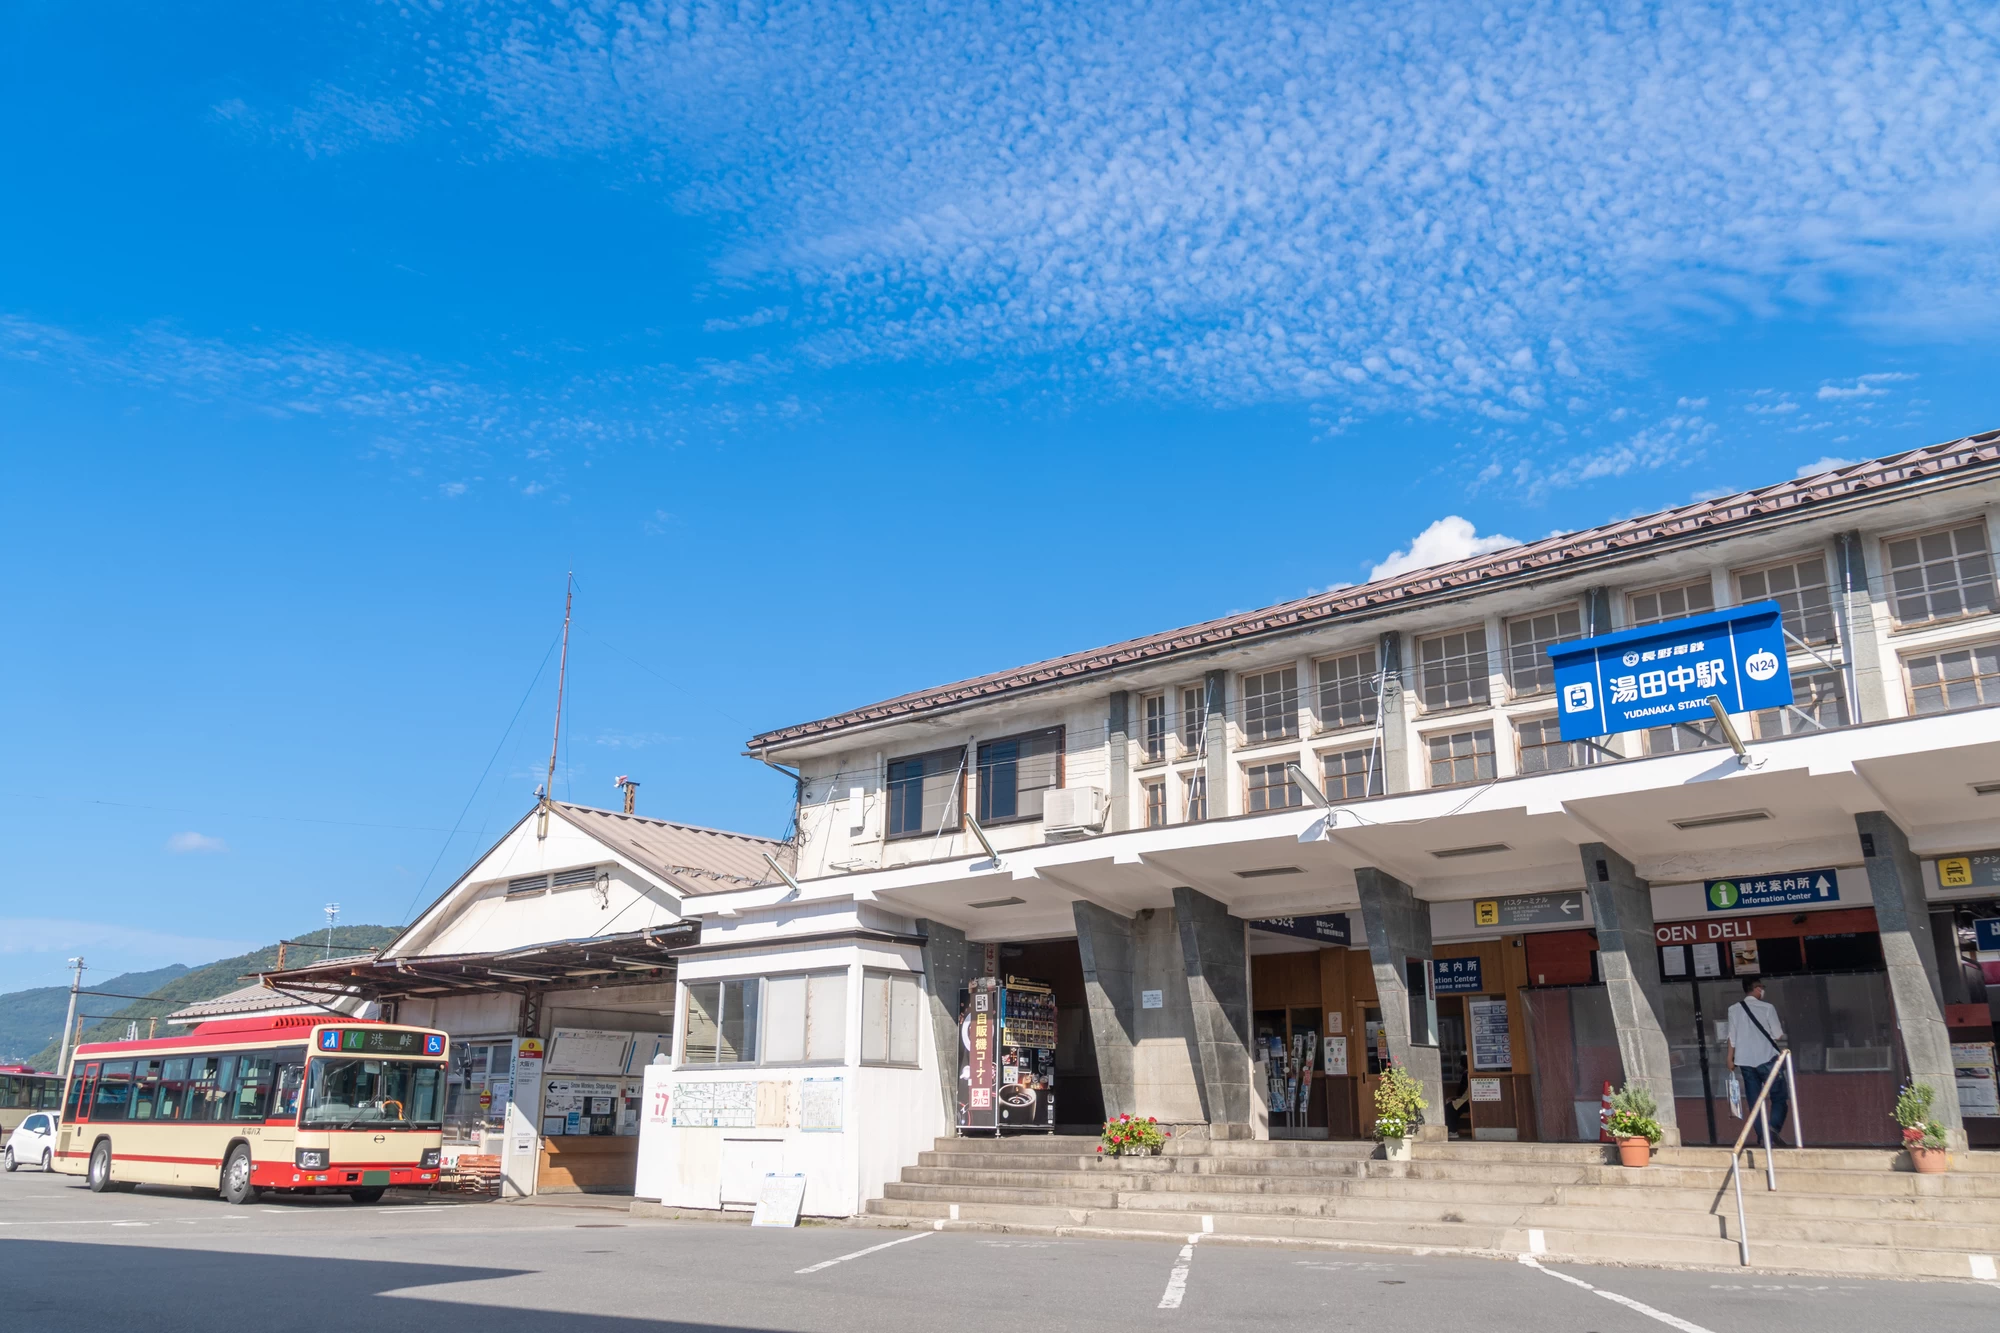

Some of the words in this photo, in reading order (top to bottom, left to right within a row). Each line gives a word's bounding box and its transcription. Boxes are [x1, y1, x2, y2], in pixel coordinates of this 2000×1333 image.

[1641, 641, 1705, 662] 長野電鉄
[1749, 658, 1776, 673] N24
[1609, 658, 1728, 705] 湯田中駅
[1623, 704, 1675, 720] YUDANAKA
[1677, 697, 1711, 711] STATIO
[1739, 877, 1810, 895] 観光案内所
[1947, 876, 1966, 884] TAXI
[1503, 897, 1549, 906] バスターミナル
[1742, 894, 1785, 905] Information
[1786, 892, 1812, 901] Center
[1707, 921, 1752, 939] DELI
[1453, 975, 1477, 983] Center
[348, 1032, 359, 1048] K
[975, 1012, 988, 1085] 自販機コーナー
